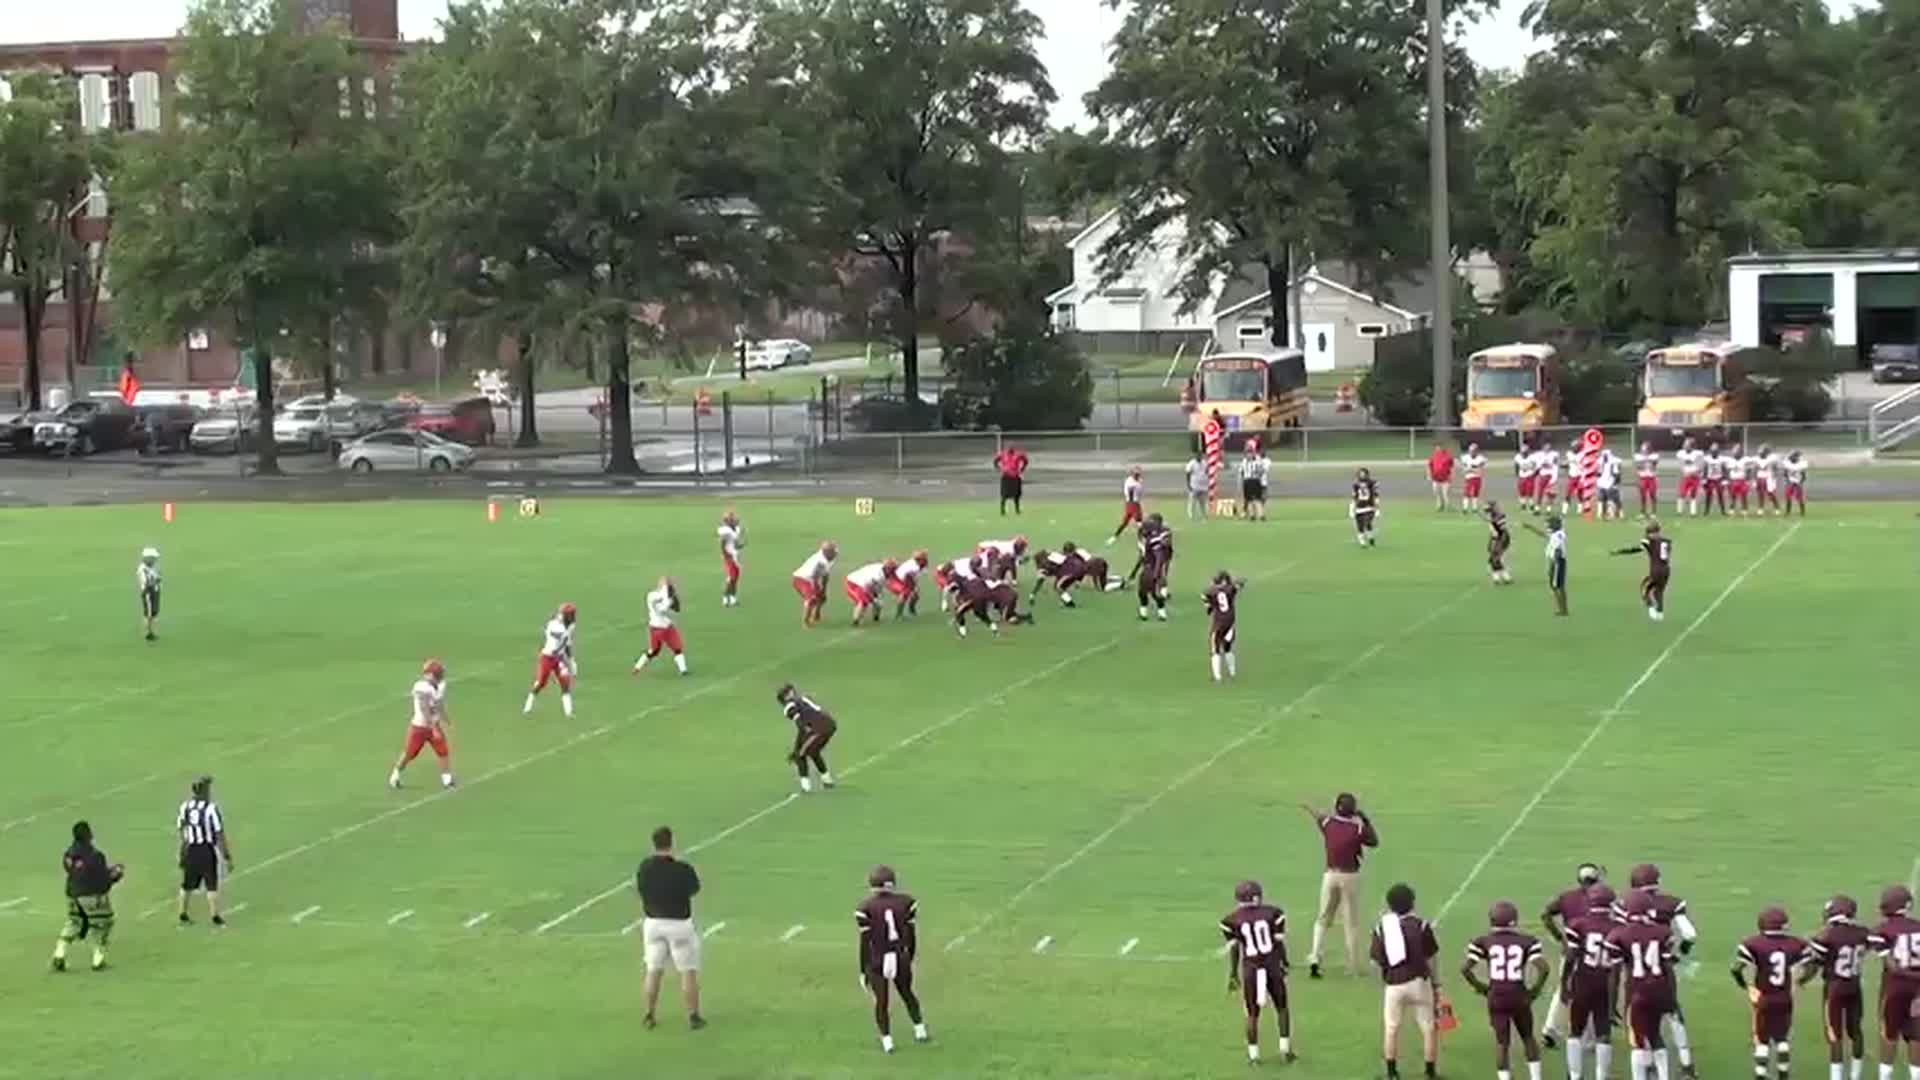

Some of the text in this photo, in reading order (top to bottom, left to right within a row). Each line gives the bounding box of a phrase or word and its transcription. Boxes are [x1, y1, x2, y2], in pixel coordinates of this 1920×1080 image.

[1217, 591, 1229, 612] 9
[884, 908, 899, 941] 1
[1241, 920, 1272, 956] 10
[1488, 944, 1523, 981] 22
[1631, 940, 1661, 978] 14
[1768, 950, 1786, 986] 3
